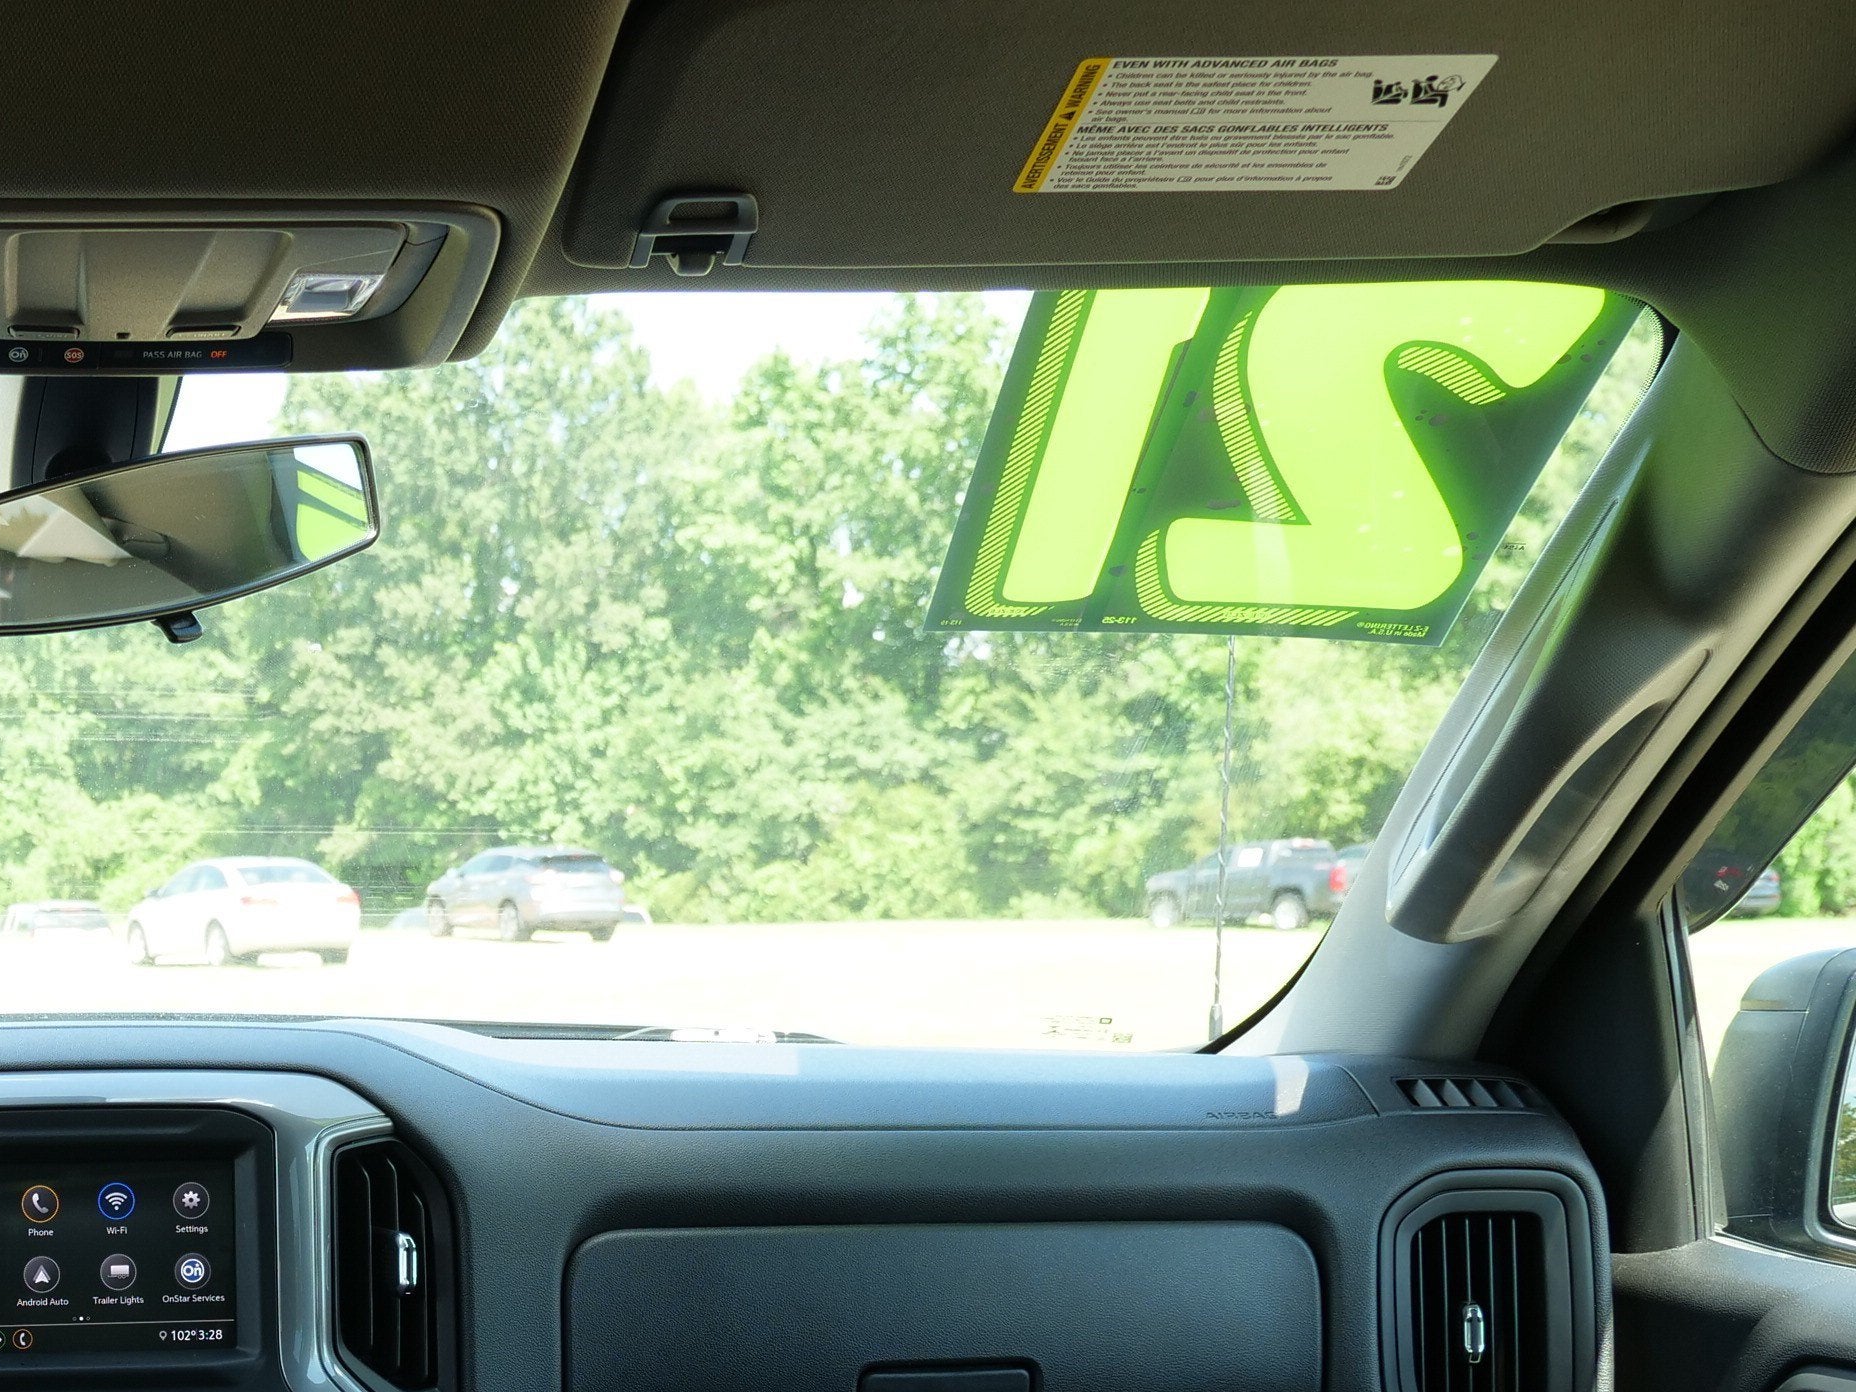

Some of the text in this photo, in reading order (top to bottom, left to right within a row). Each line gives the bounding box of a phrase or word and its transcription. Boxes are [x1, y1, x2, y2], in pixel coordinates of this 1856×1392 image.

[1112, 59, 1339, 69] EVEN WITH ADVANCED AIR BAGS
[1065, 64, 1101, 109] WARNING
[1077, 124, 1389, 134] MÊME AVEC DES SACS GONFLABLES INTELLIGENTS
[1021, 122, 1069, 189] AVERTISSEMENT
[184, 351, 202, 359] BAG
[210, 351, 227, 359] OFF
[28, 1228, 54, 1237] Phone
[106, 1226, 128, 1235] Wi-Fi
[175, 1224, 209, 1235] Settings
[17, 1297, 69, 1307] Android Auto
[93, 1295, 144, 1306] Trailer Lights
[162, 1293, 225, 1303] OnStar Services
[198, 1329, 223, 1341] 3:28
